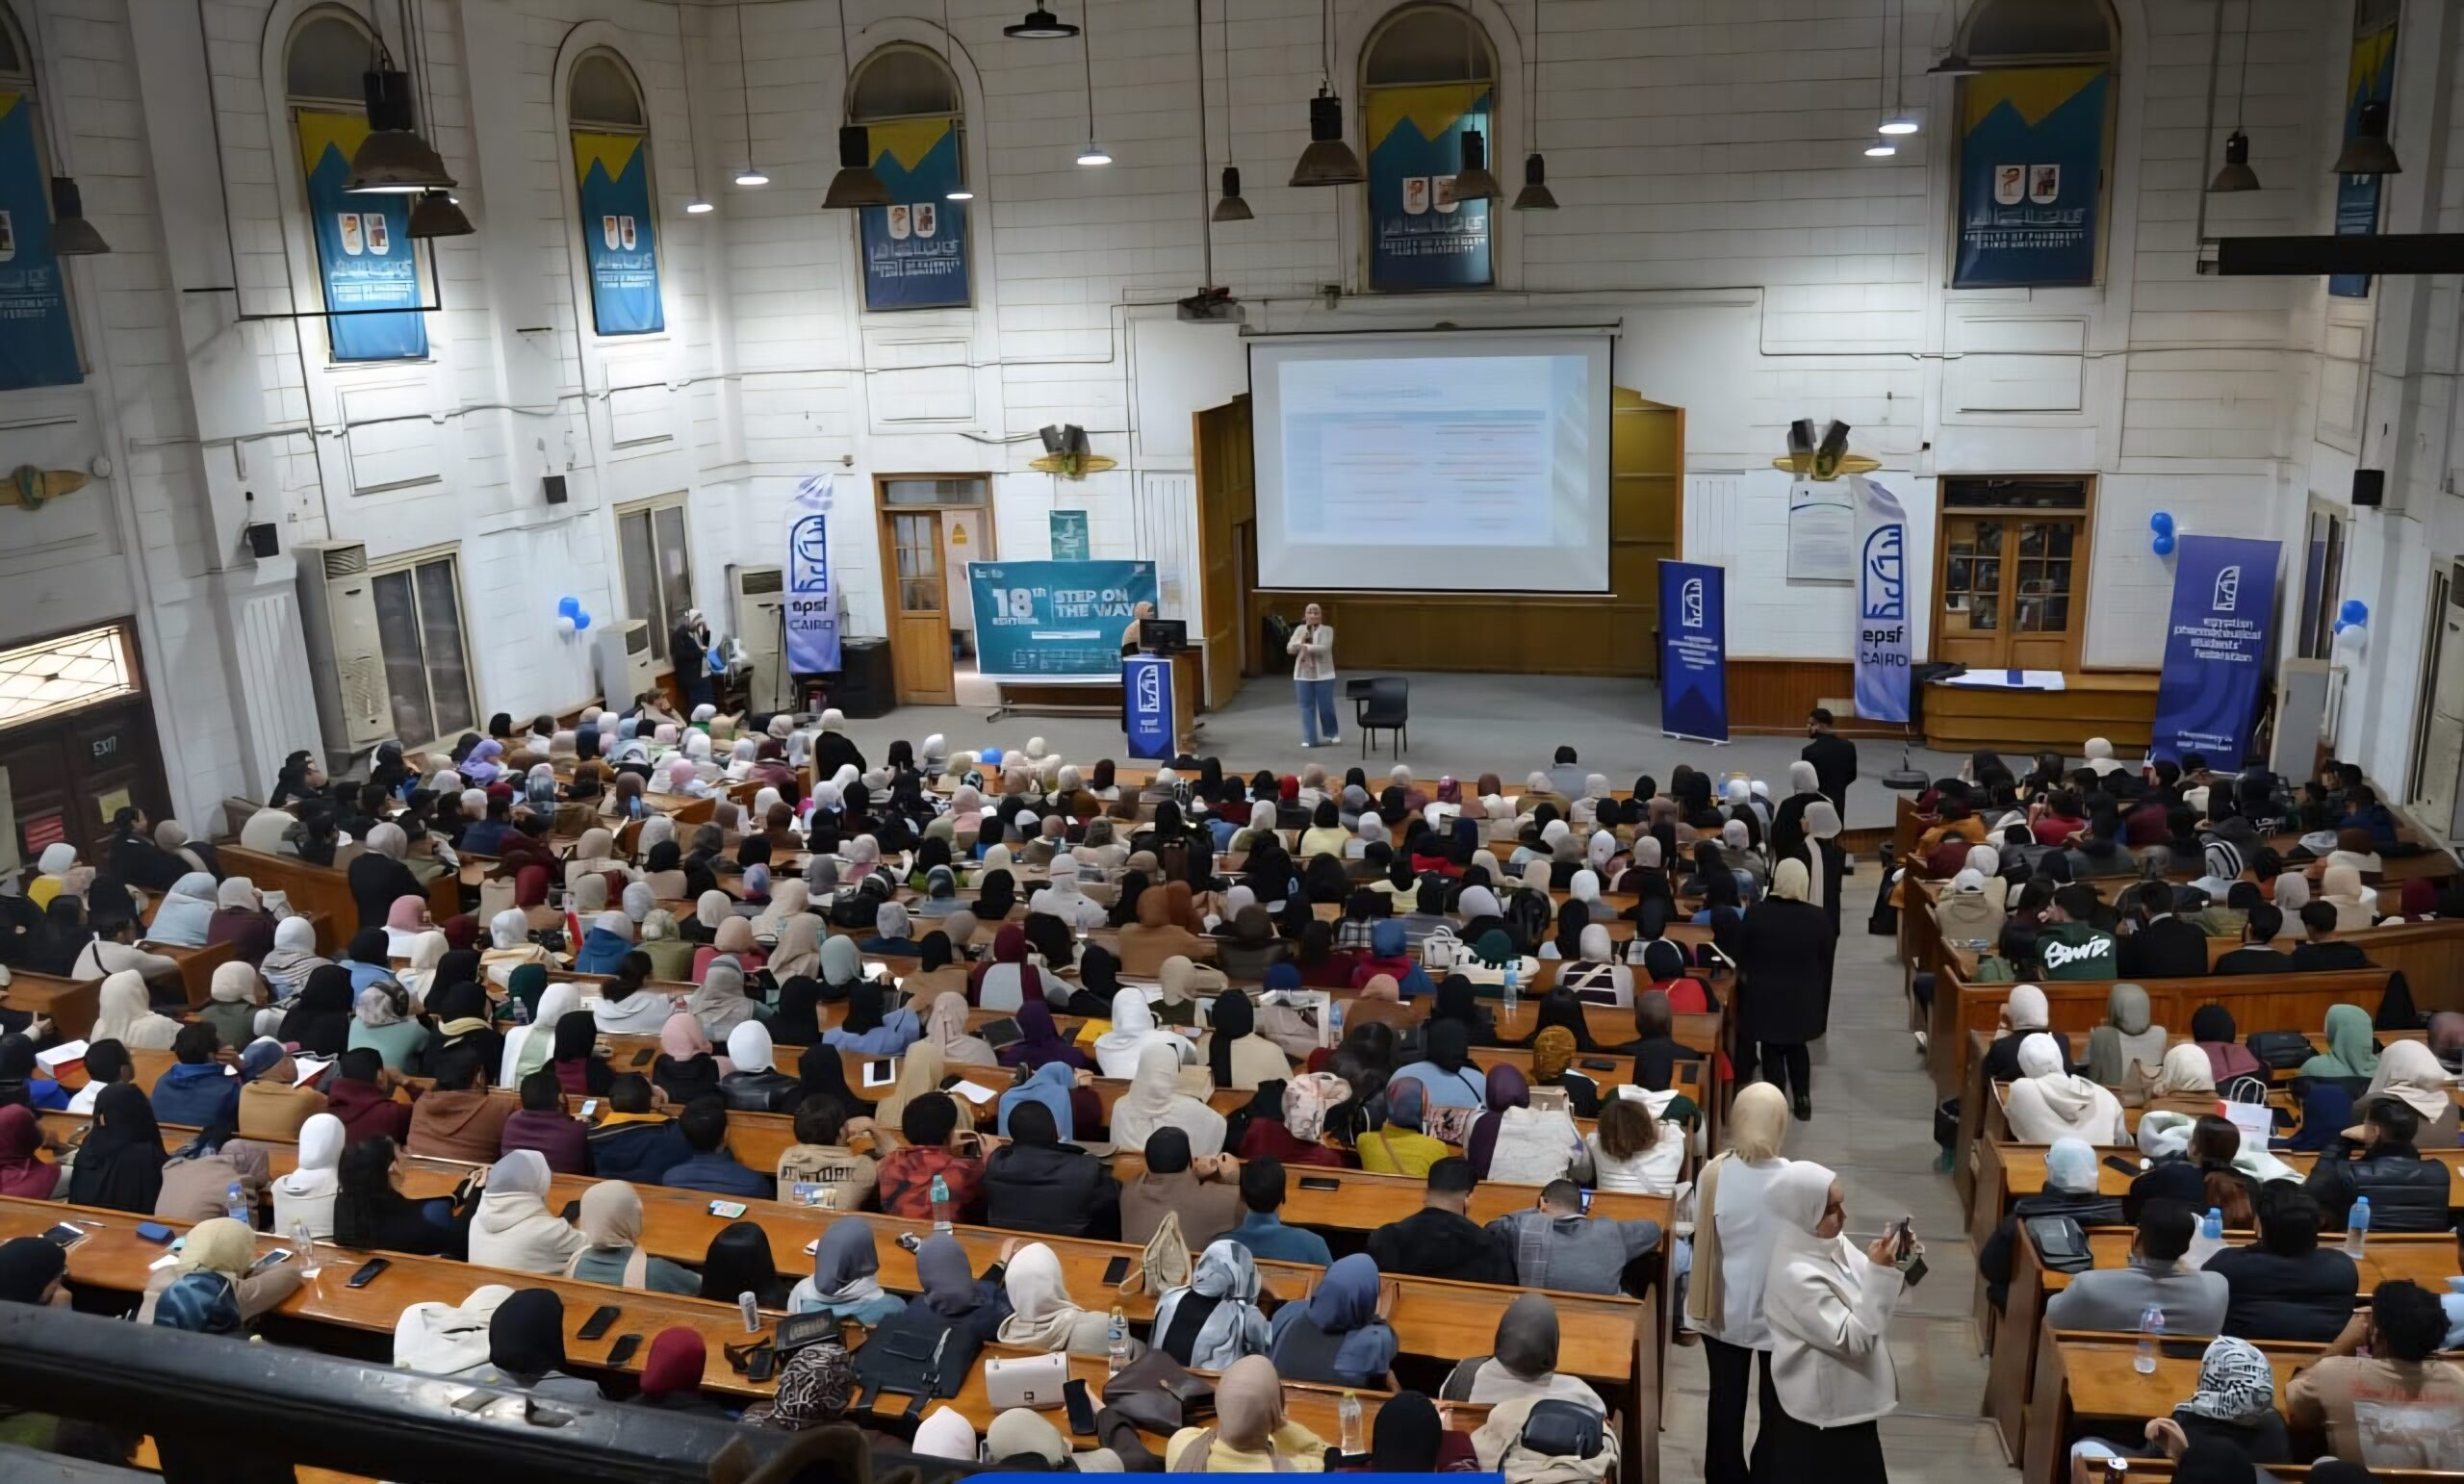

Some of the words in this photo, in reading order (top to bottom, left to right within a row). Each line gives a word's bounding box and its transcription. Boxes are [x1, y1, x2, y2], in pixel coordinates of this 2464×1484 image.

[1054, 589, 1096, 603] STEP
[1101, 588, 1129, 602] ON
[1055, 602, 1090, 617] THE
[1093, 602, 1135, 617] WAY
[1862, 625, 1904, 649] epsf
[1861, 651, 1909, 669] CAIRO
